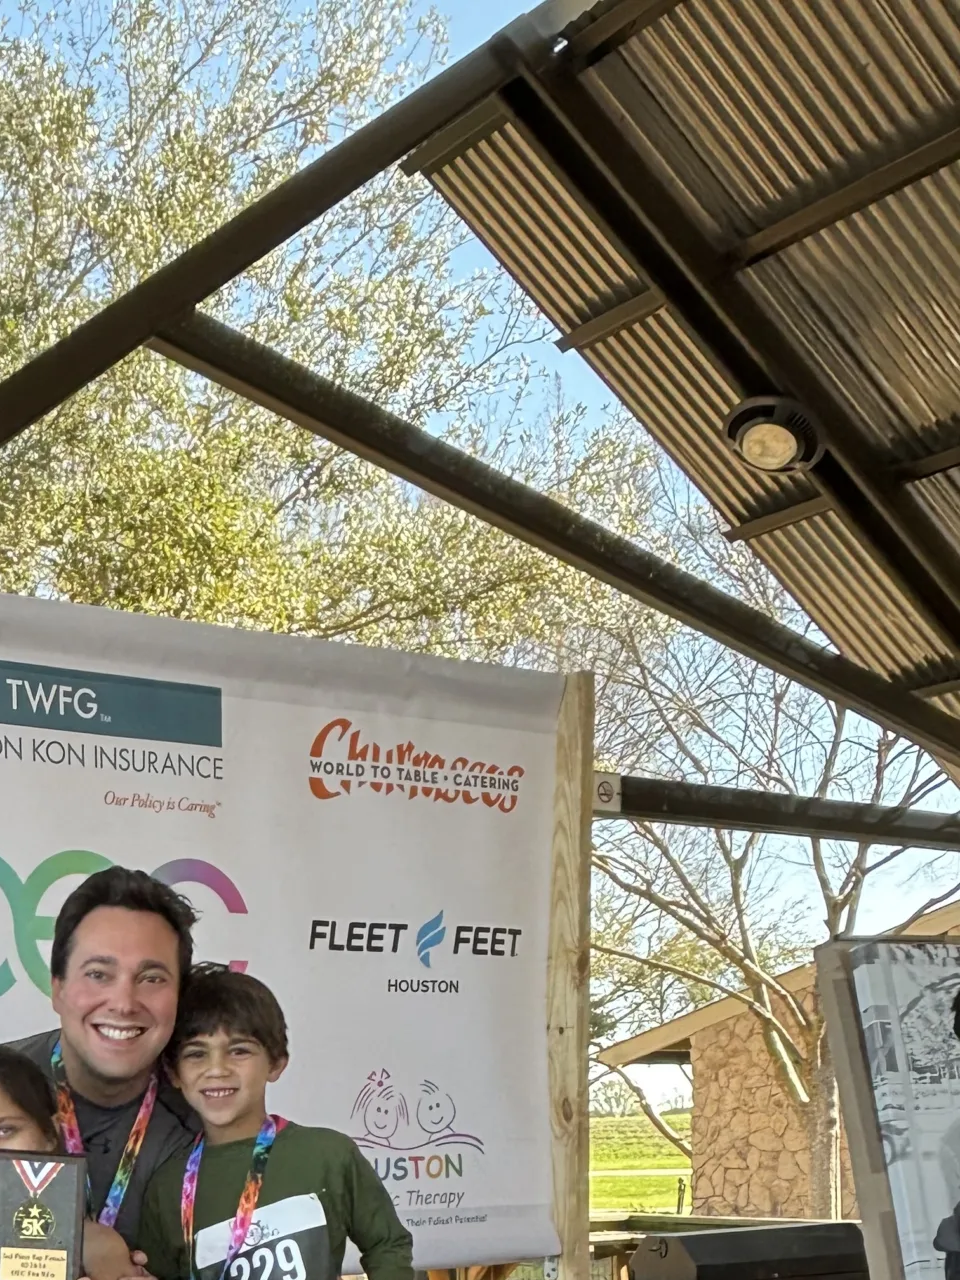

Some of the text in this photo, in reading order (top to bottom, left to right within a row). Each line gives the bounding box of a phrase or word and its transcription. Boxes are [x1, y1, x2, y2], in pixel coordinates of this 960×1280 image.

[6, 679, 98, 719] TWFG
[32, 738, 85, 767] KON
[94, 745, 223, 780] INSURANCE
[309, 760, 520, 792] WORLD TO TABLE CATERING
[104, 790, 129, 806] Our
[130, 793, 165, 813] Policy
[166, 797, 176, 810] is
[309, 919, 522, 957] FLEET FEET
[387, 979, 459, 993] HOUSTON
[374, 1153, 463, 1181] USTON
[406, 1189, 465, 1208] Therapy
[21, 1218, 46, 1236] 5K
